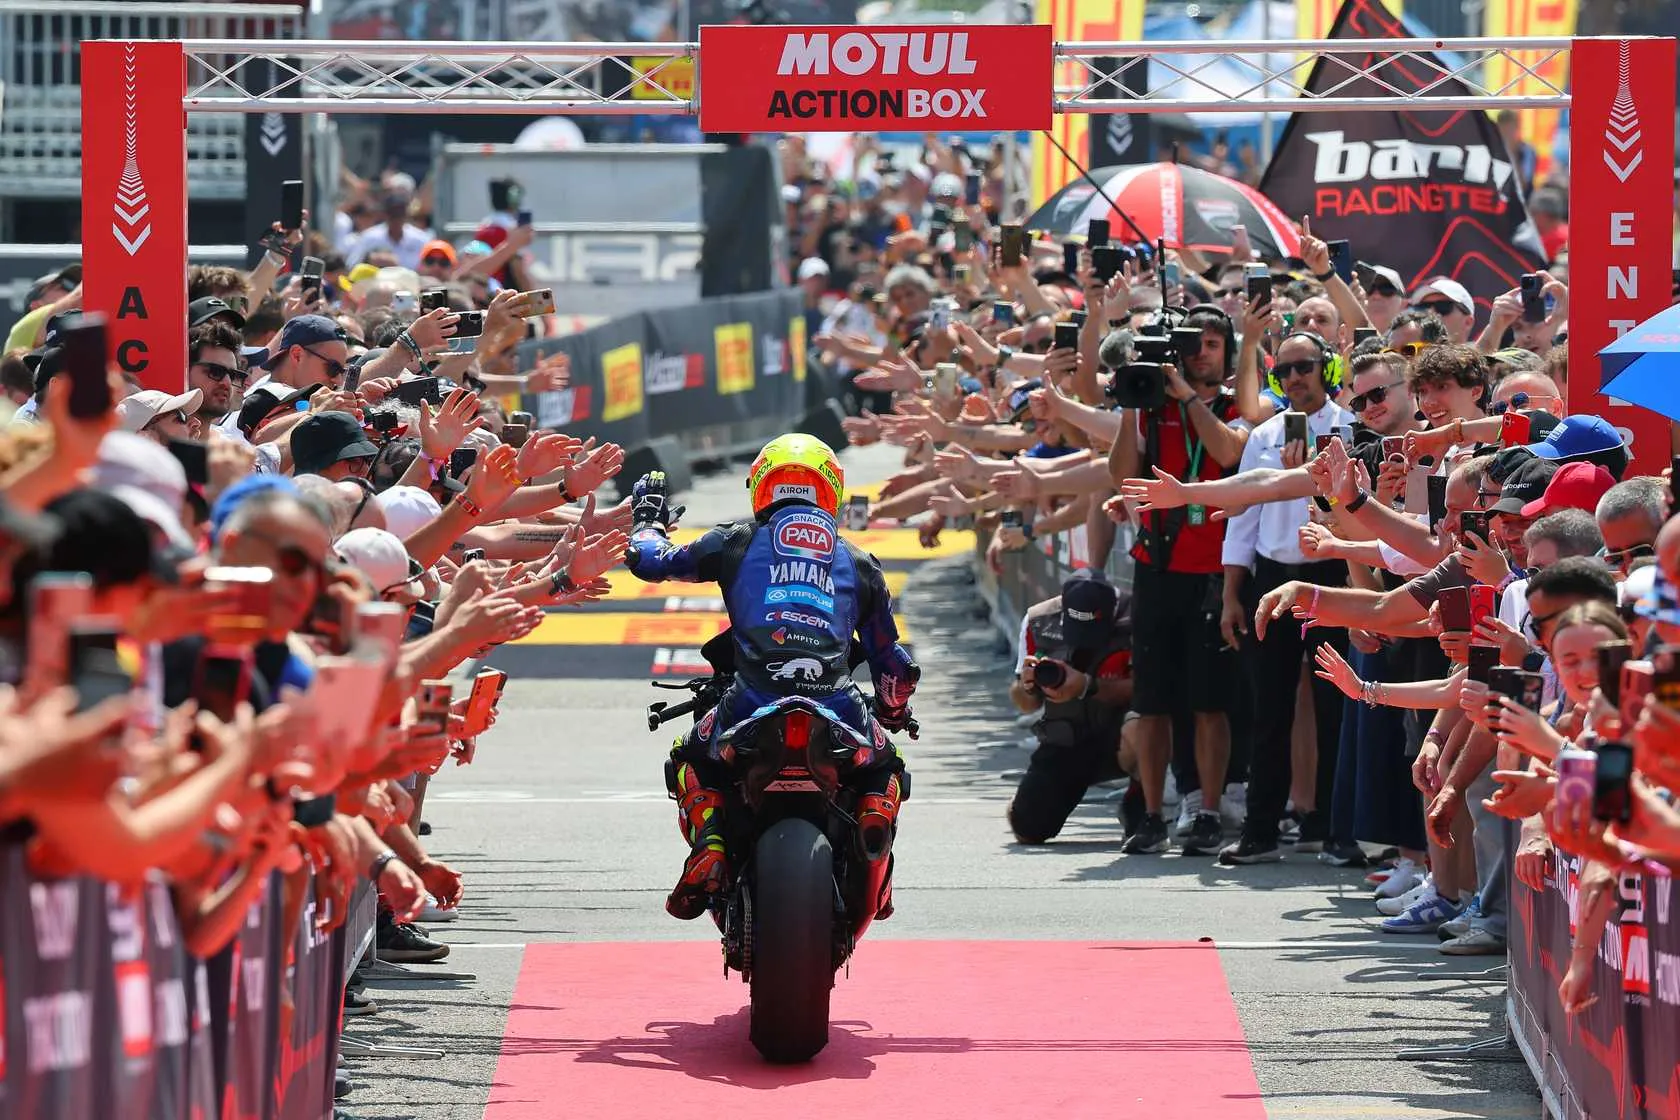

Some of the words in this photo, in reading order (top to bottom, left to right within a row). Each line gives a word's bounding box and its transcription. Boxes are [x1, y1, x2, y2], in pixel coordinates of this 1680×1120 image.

[777, 32, 977, 76] MOTUL
[818, 464, 840, 489] AIROH
[779, 486, 809, 495] AIROH
[785, 527, 829, 549] PATA
[769, 561, 835, 595] YAMAHA
[786, 633, 820, 646] AMPITO
